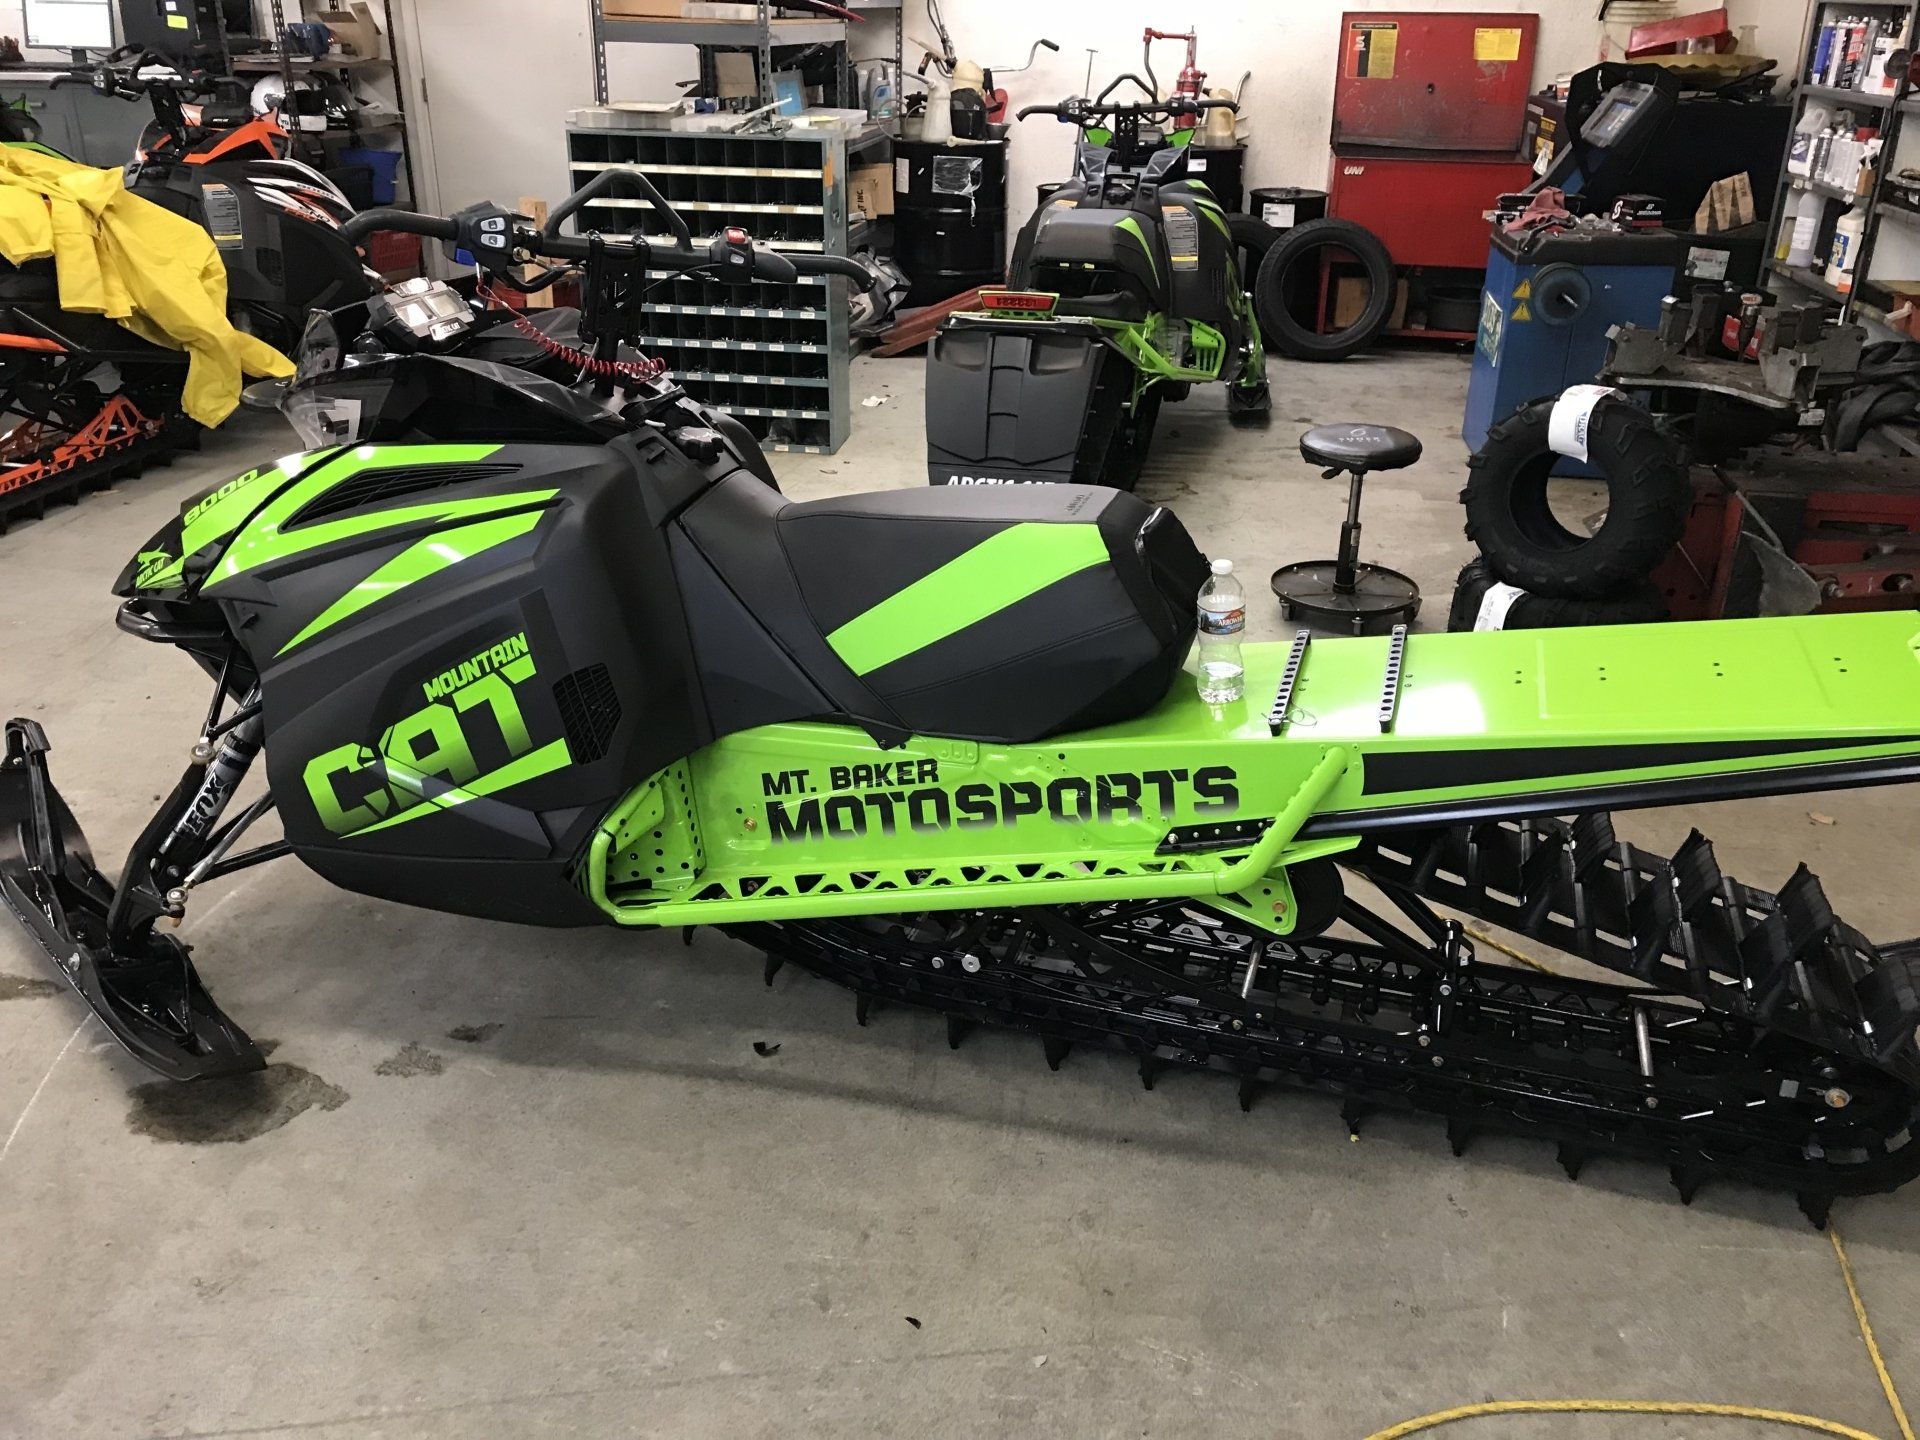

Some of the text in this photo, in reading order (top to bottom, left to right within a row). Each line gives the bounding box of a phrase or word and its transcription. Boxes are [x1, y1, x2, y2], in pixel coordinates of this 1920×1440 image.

[184, 469, 258, 527] 8000
[152, 557, 165, 573] CAT
[422, 631, 529, 702] MOUNTAIN
[303, 653, 537, 834] CAT
[184, 772, 222, 836] FOX
[761, 758, 940, 797] MT. BAKER
[765, 765, 1240, 845] MOTOSPORTS
